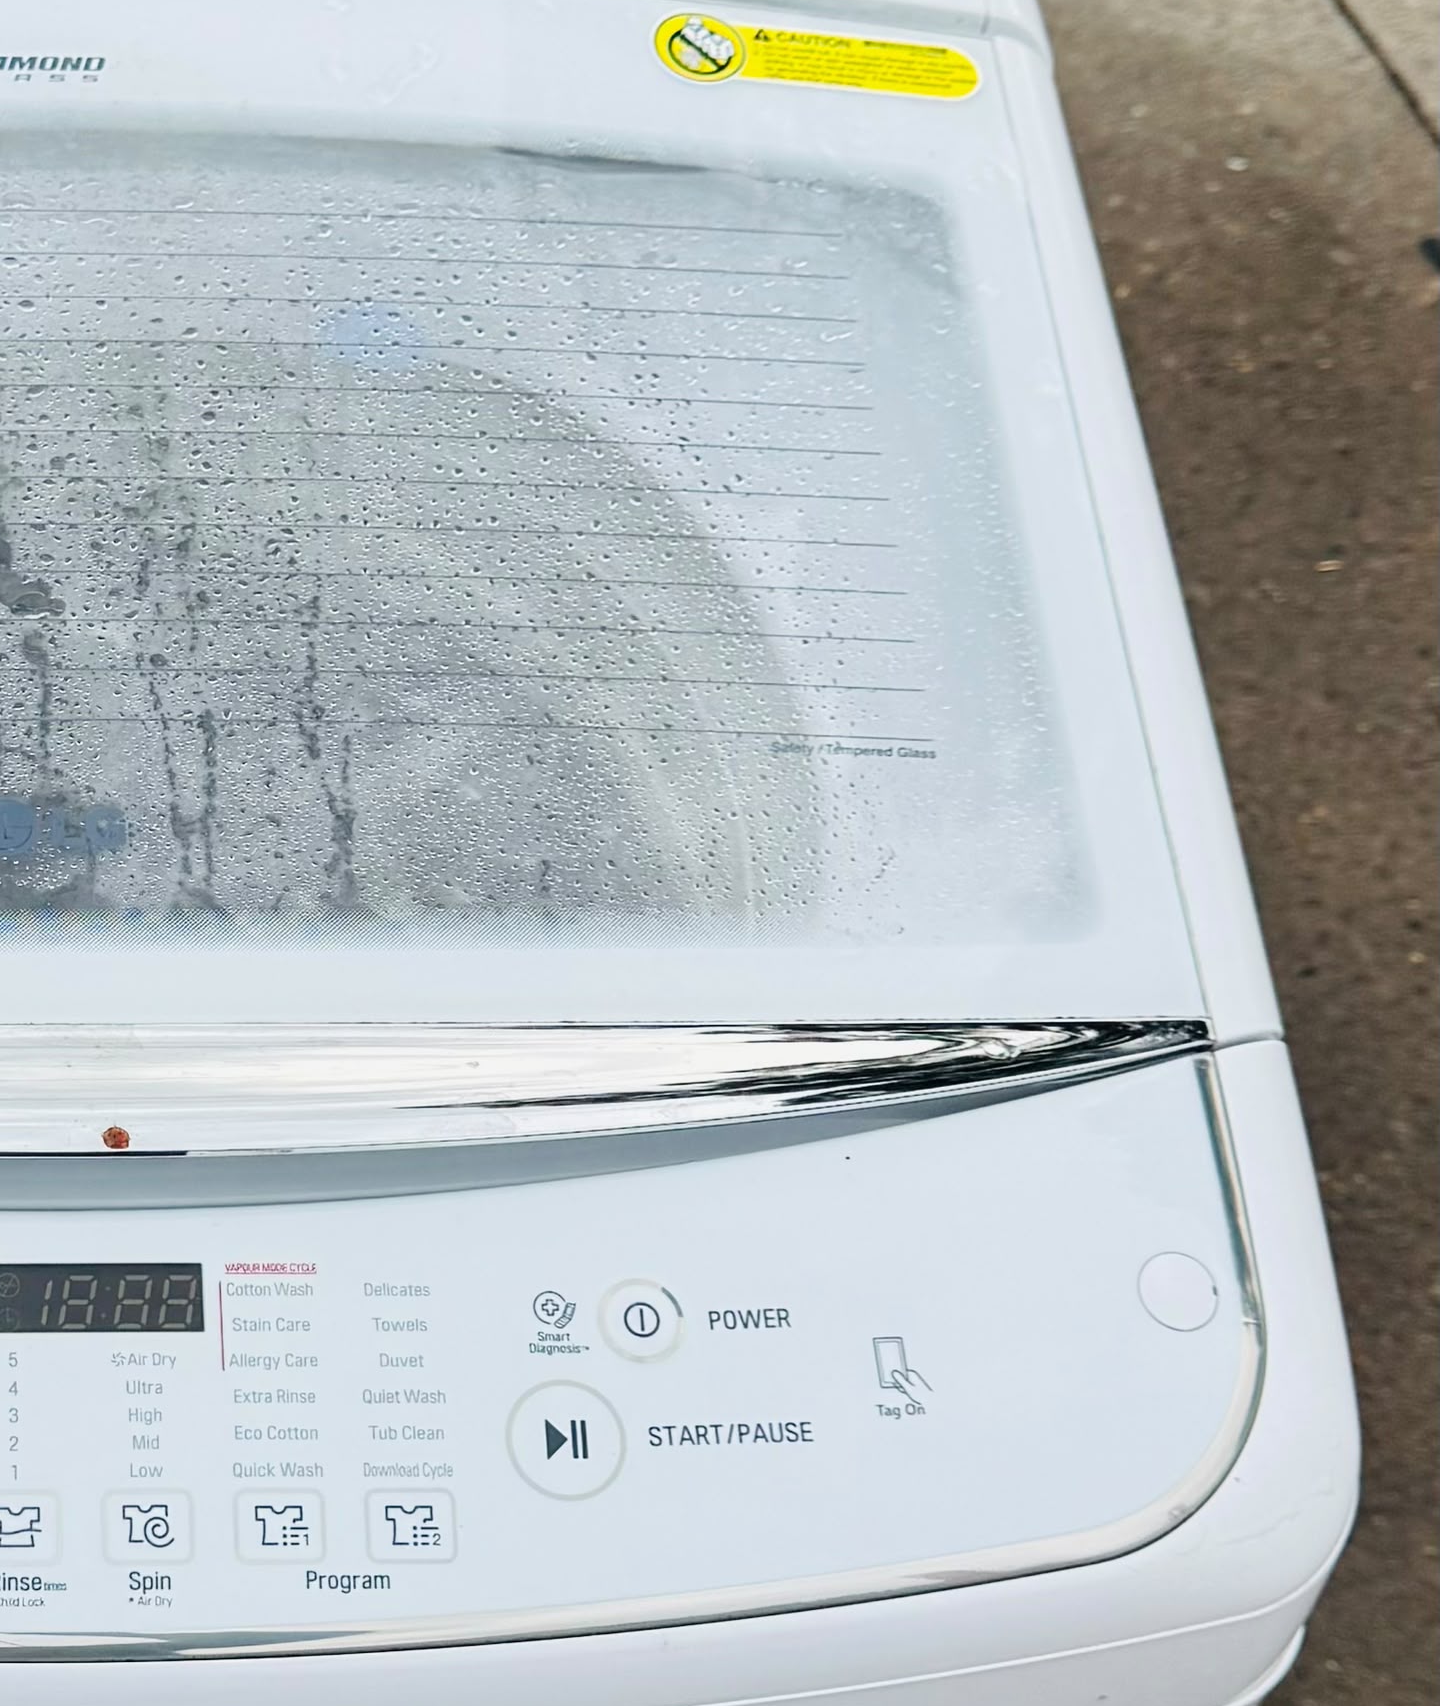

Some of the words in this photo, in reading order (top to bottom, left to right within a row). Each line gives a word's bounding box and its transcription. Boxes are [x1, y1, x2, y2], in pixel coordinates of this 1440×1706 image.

[897, 747, 937, 759] Glass
[226, 1282, 271, 1297] Cotton
[274, 1282, 314, 1297] Wash
[363, 1282, 431, 1297] Delicates
[232, 1317, 271, 1332] Stain
[275, 1317, 311, 1332] Care
[372, 1317, 428, 1332] Towels
[708, 1308, 792, 1331] POWER
[537, 1331, 570, 1342] Smart
[8, 1352, 19, 1367] 5
[127, 1353, 148, 1366] Air
[152, 1353, 177, 1369] Dry
[229, 1353, 280, 1370] Allergy
[285, 1353, 318, 1368] Care
[379, 1353, 424, 1368] Duvet
[8, 1380, 19, 1396] 4
[126, 1380, 164, 1395] Ultra
[233, 1389, 273, 1404] Extra
[276, 1389, 316, 1404] Rinse
[362, 1389, 401, 1405] Quiet
[403, 1389, 446, 1404] Wash
[8, 1407, 19, 1424] 3
[128, 1407, 163, 1426] High
[876, 1404, 902, 1420] Tag
[905, 1403, 926, 1417] On
[234, 1425, 262, 1440] Eco
[267, 1425, 319, 1440] Cotton
[368, 1425, 397, 1440] Tub
[402, 1425, 445, 1440] Clean
[648, 1422, 815, 1448] START/PAUSE
[8, 1435, 19, 1452] 2
[132, 1435, 160, 1450] Mid
[11, 1464, 18, 1481] 1
[129, 1463, 164, 1478] Low
[232, 1462, 275, 1479] Quick
[280, 1462, 324, 1478] Wash
[363, 1462, 419, 1478] Download
[422, 1462, 453, 1480] Cycle
[128, 1571, 172, 1594] Spin
[305, 1570, 391, 1593] Program
[22, 1596, 46, 1607] Lock
[137, 1596, 152, 1606] Air
[154, 1596, 173, 1608] Dry
